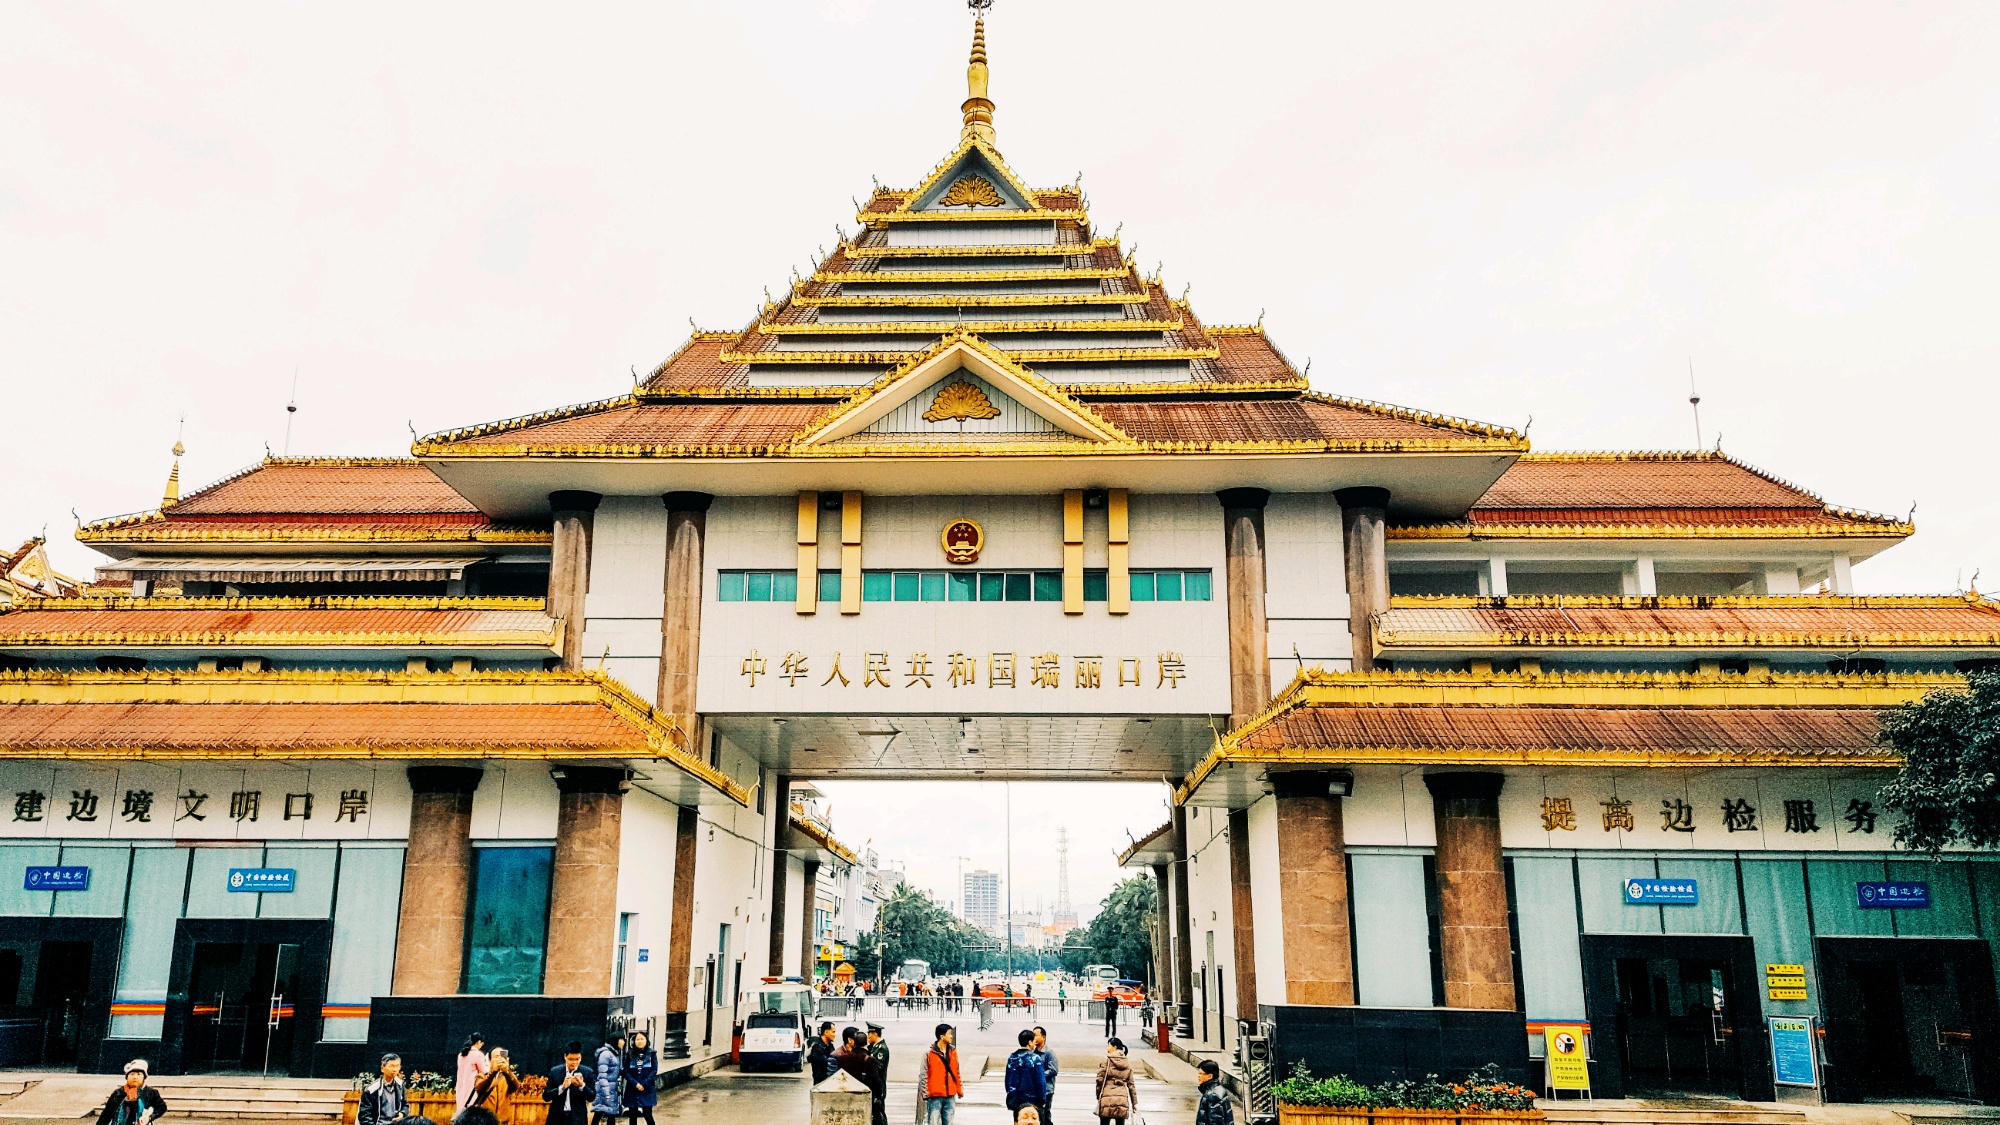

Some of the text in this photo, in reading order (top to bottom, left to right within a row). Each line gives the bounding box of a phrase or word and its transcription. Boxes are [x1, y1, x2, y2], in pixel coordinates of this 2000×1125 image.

[739, 648, 1187, 690] 中华人民共和国瑞丽口岸
[12, 788, 368, 823] 建边境文明口岸
[1542, 796, 1878, 834] 提高边检服务
